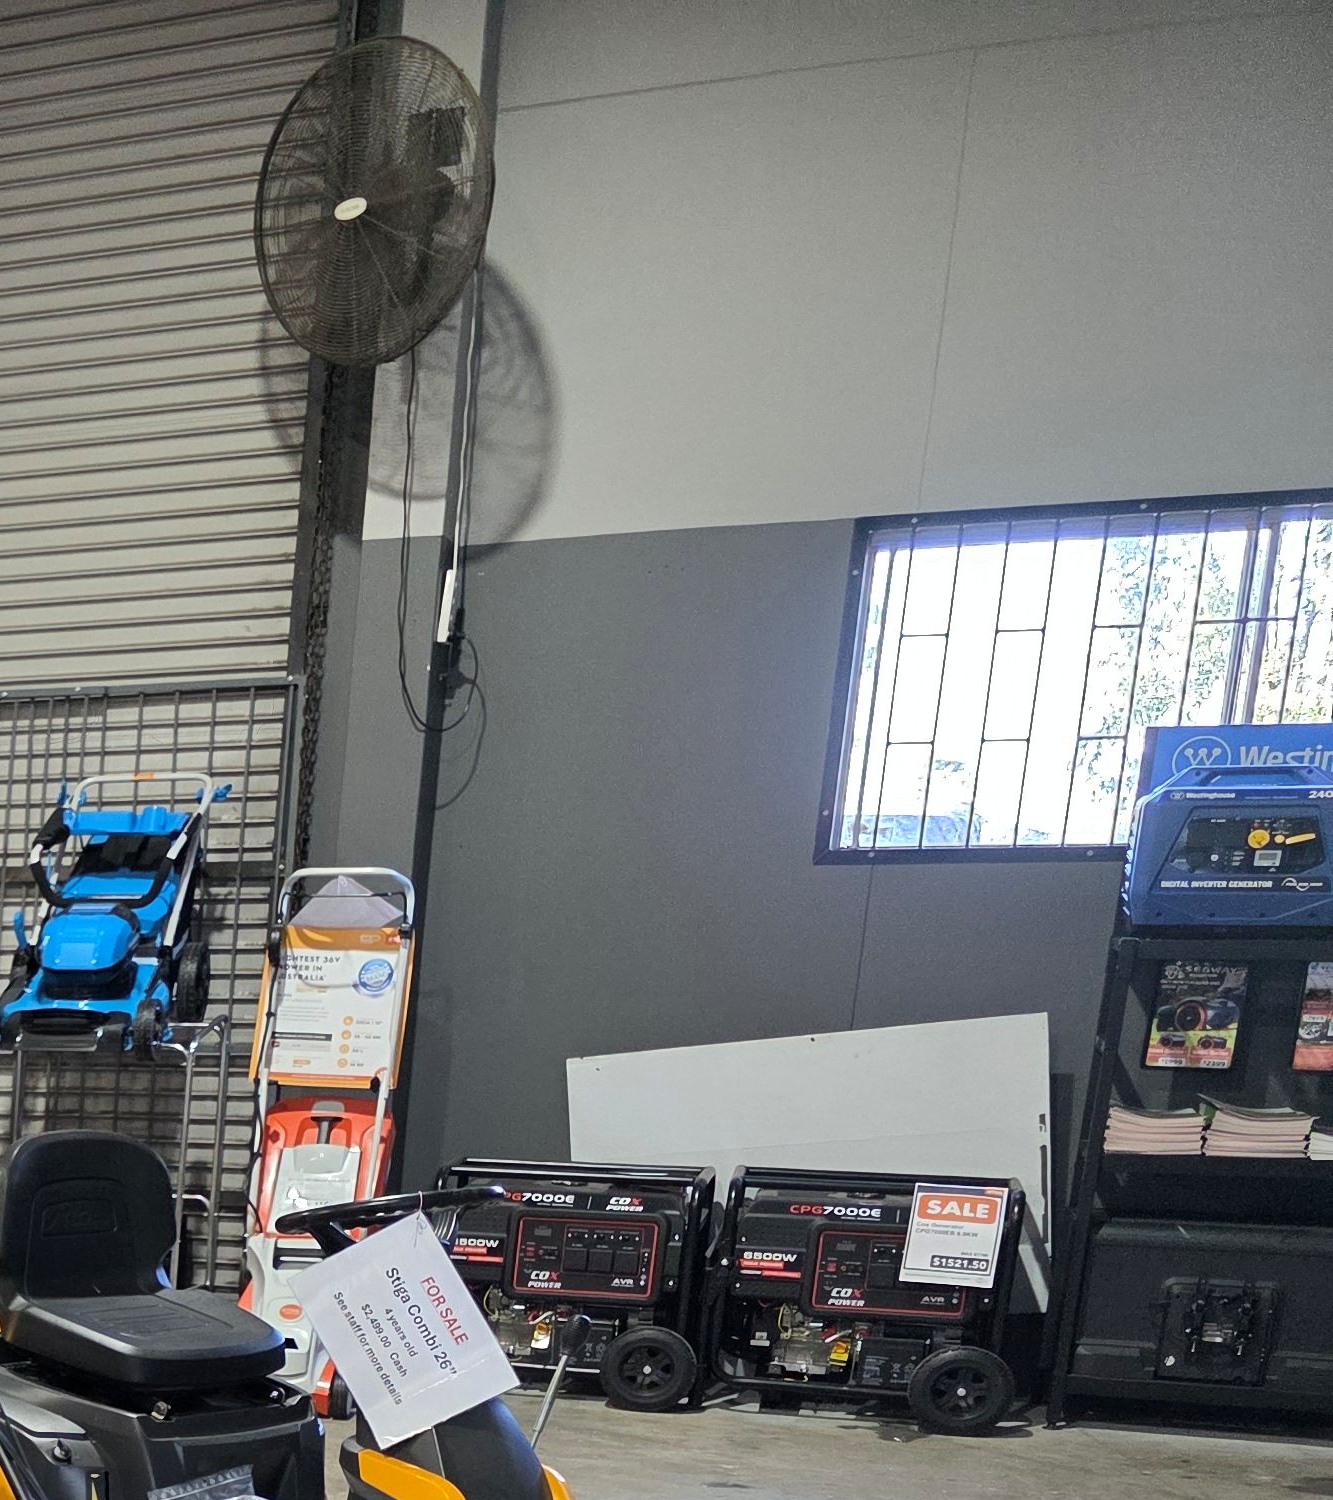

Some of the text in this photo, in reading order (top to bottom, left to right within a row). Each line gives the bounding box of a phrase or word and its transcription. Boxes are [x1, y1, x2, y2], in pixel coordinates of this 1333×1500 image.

[1160, 880, 1273, 888] DIGITAL INVERTER GENERATOR
[609, 1196, 642, 1206] COX
[605, 1205, 644, 1213] POWER
[789, 1203, 882, 1218] CPG7000E
[925, 1199, 990, 1219] SALE
[454, 1237, 500, 1249] 500W
[932, 1257, 987, 1270] $1521.50
[530, 1270, 560, 1281] COX
[527, 1280, 562, 1289] POWER
[830, 1287, 864, 1298] COX
[827, 1298, 865, 1307] POWER
[921, 1295, 945, 1305] AVR
[385, 1267, 411, 1304] Stiga
[407, 1304, 443, 1352] Combi
[420, 1276, 469, 1346] FOR SALE
[384, 1307, 419, 1358] 4 years old
[361, 1303, 408, 1378] $2,499.00 Cash
[334, 1291, 403, 1406] See staff for more details
